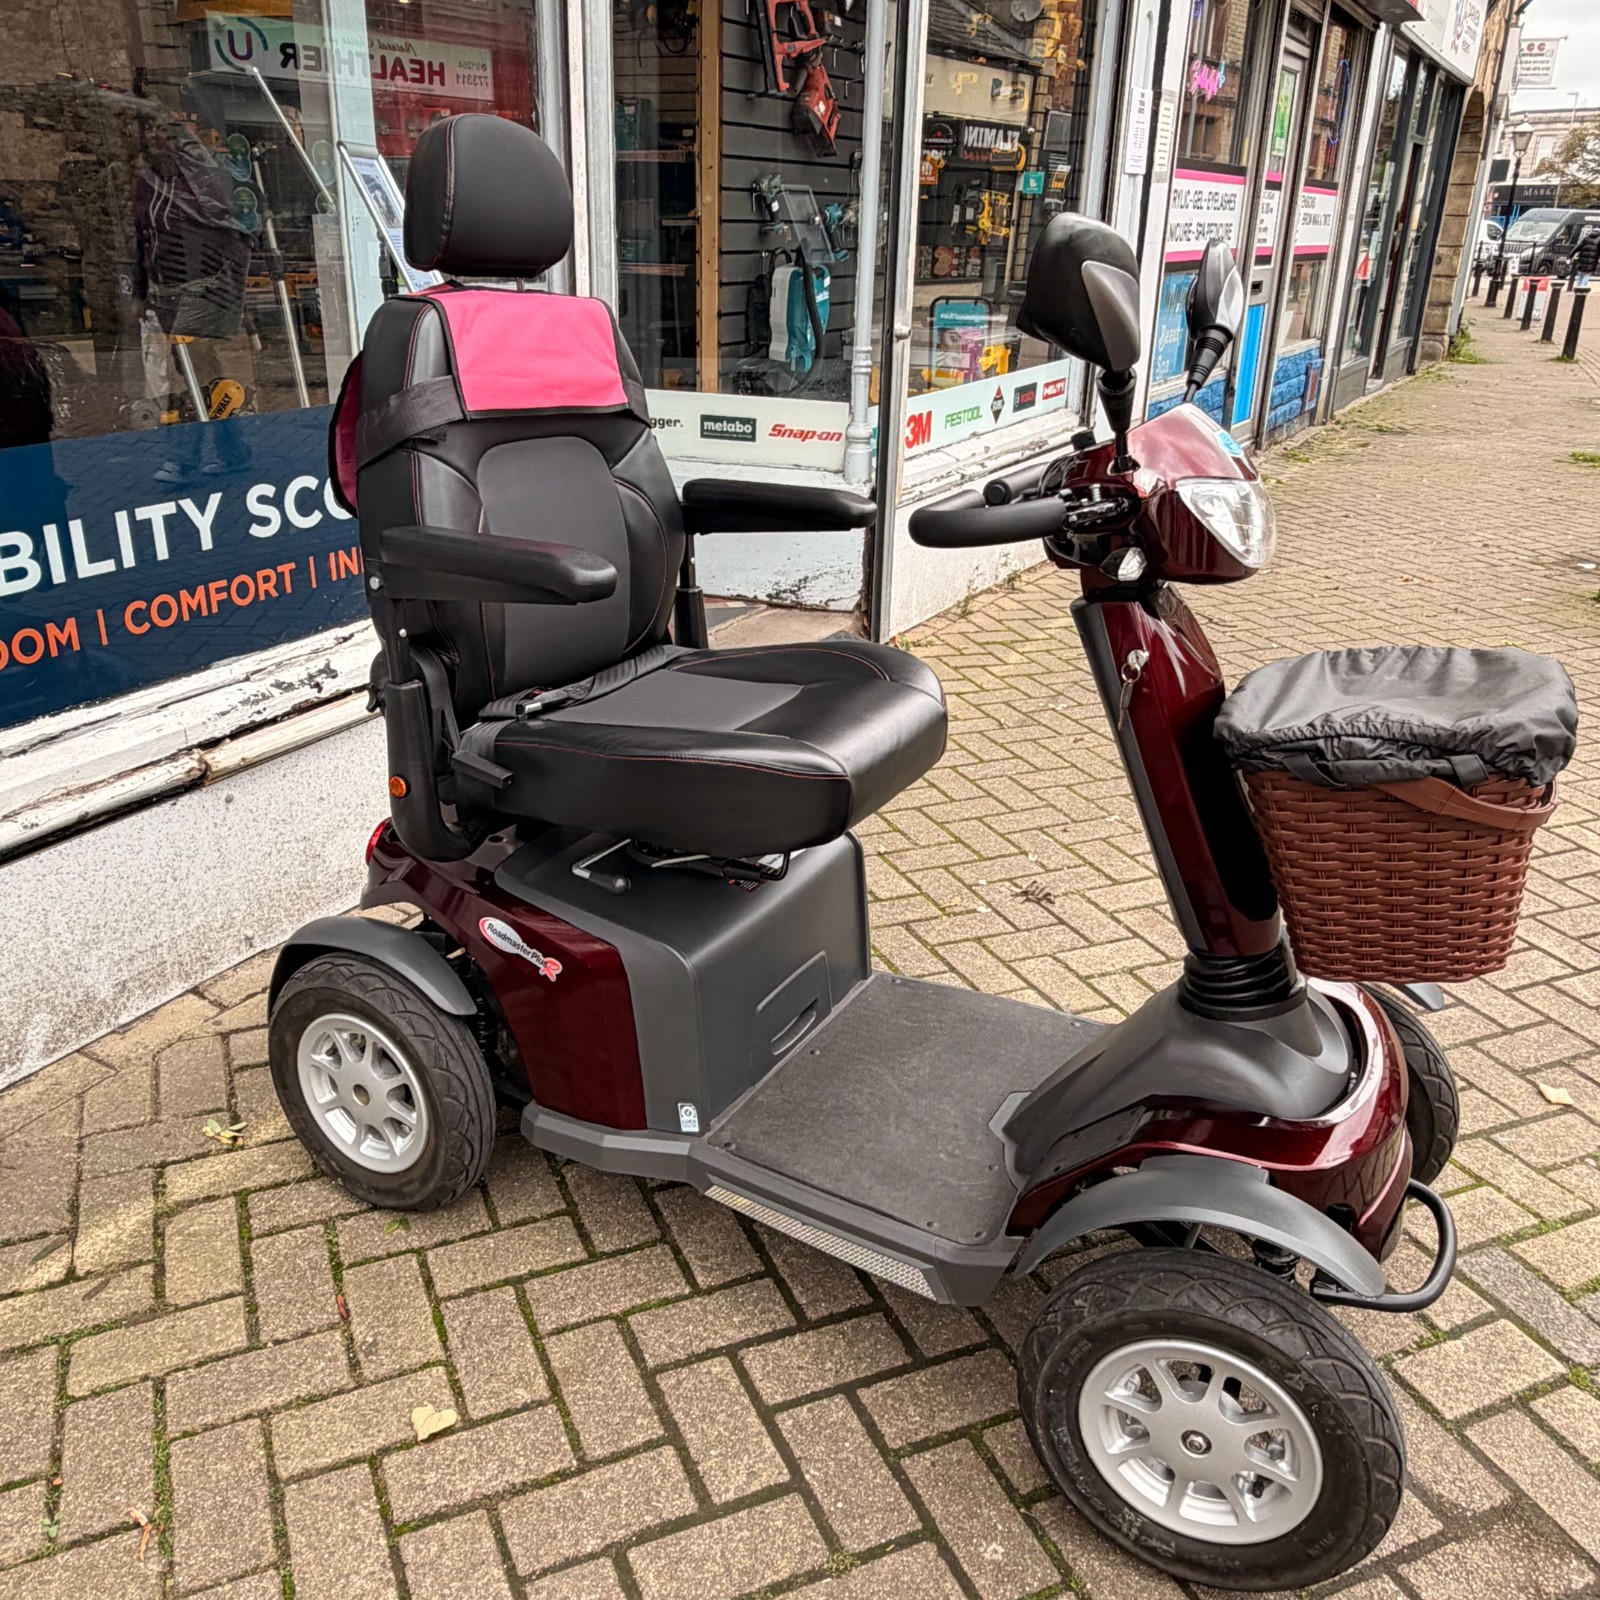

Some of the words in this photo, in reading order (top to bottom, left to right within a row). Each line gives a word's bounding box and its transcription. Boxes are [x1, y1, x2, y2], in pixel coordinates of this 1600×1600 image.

[1043, 380, 1065, 397] HILTI
[703, 420, 753, 434] metabo
[945, 405, 983, 429] FESTOOL
[768, 423, 843, 443] Snap-on
[905, 410, 932, 449] 3M
[0, 492, 222, 598] BILITY
[124, 562, 296, 635] COMFORT
[329, 546, 364, 582] IN
